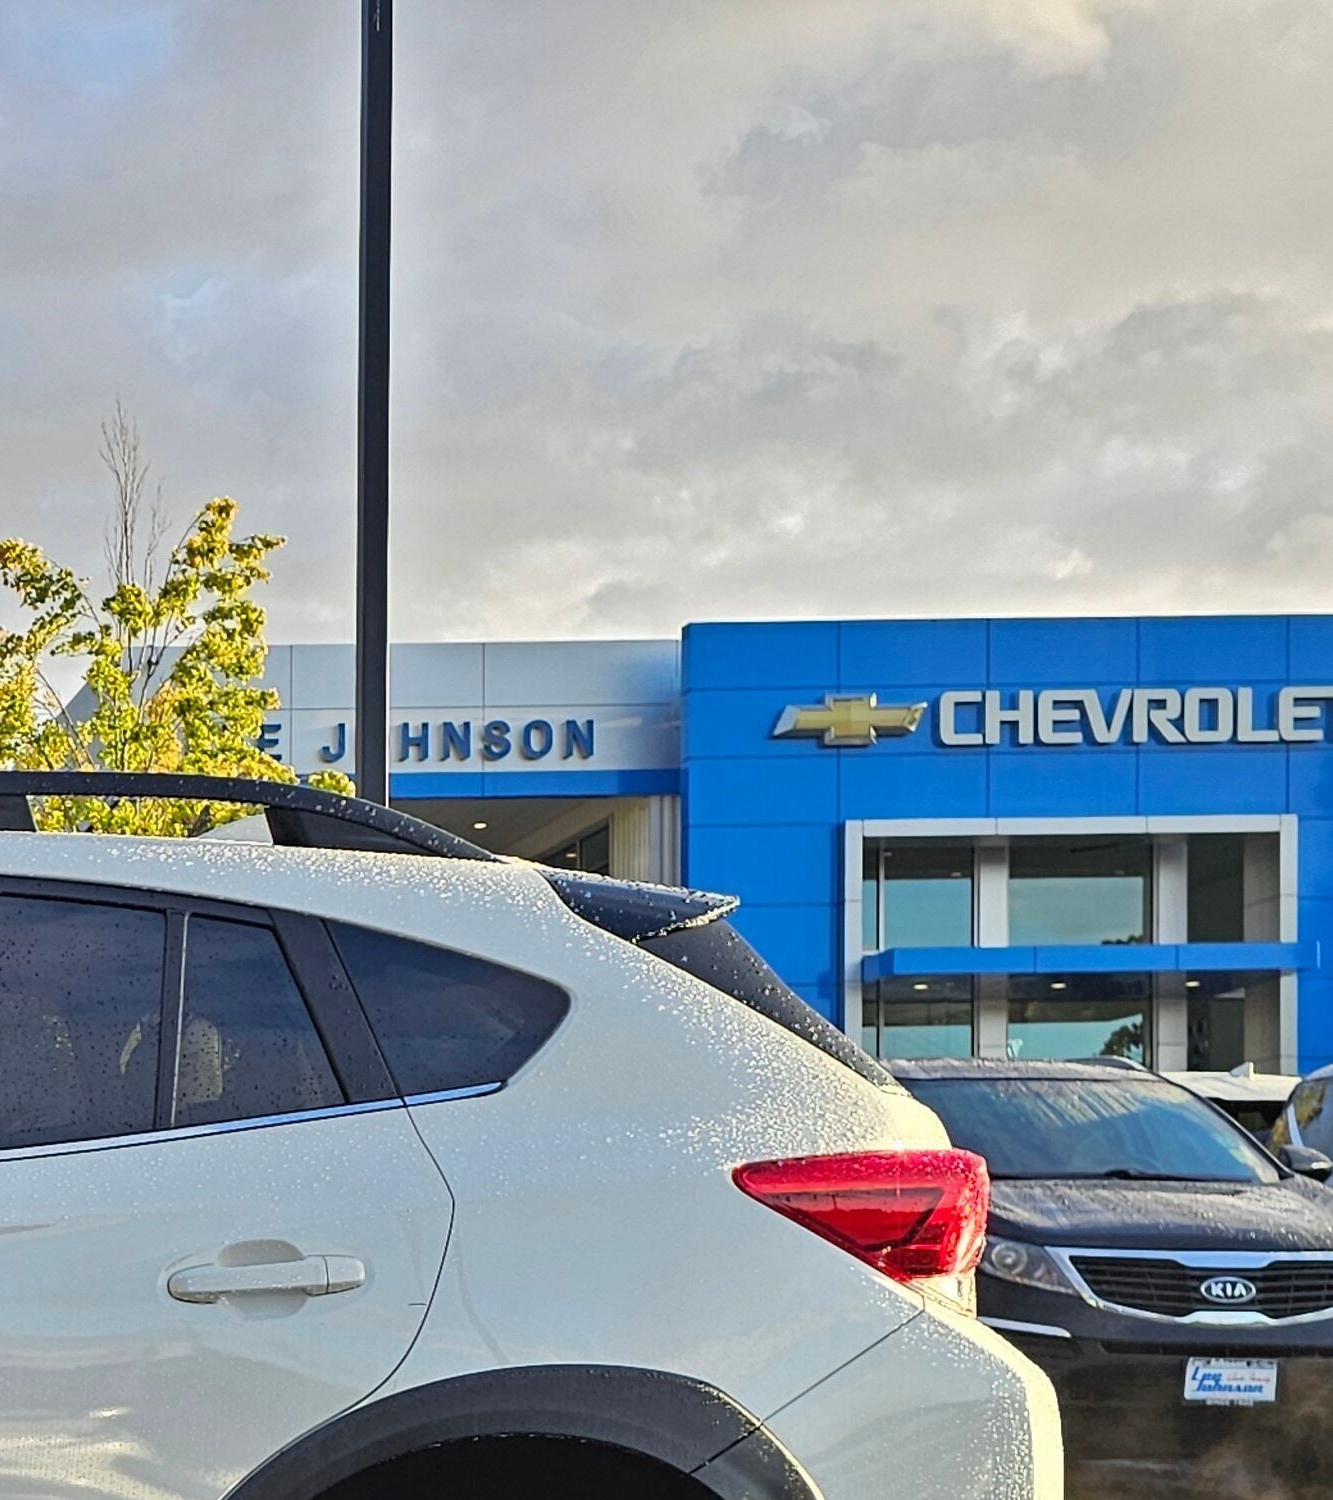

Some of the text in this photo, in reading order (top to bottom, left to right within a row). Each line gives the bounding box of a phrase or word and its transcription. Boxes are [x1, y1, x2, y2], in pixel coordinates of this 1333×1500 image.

[939, 686, 1333, 745] CHEVROLE
[320, 719, 595, 762] JHNSON
[1210, 1282, 1247, 1298] KIA
